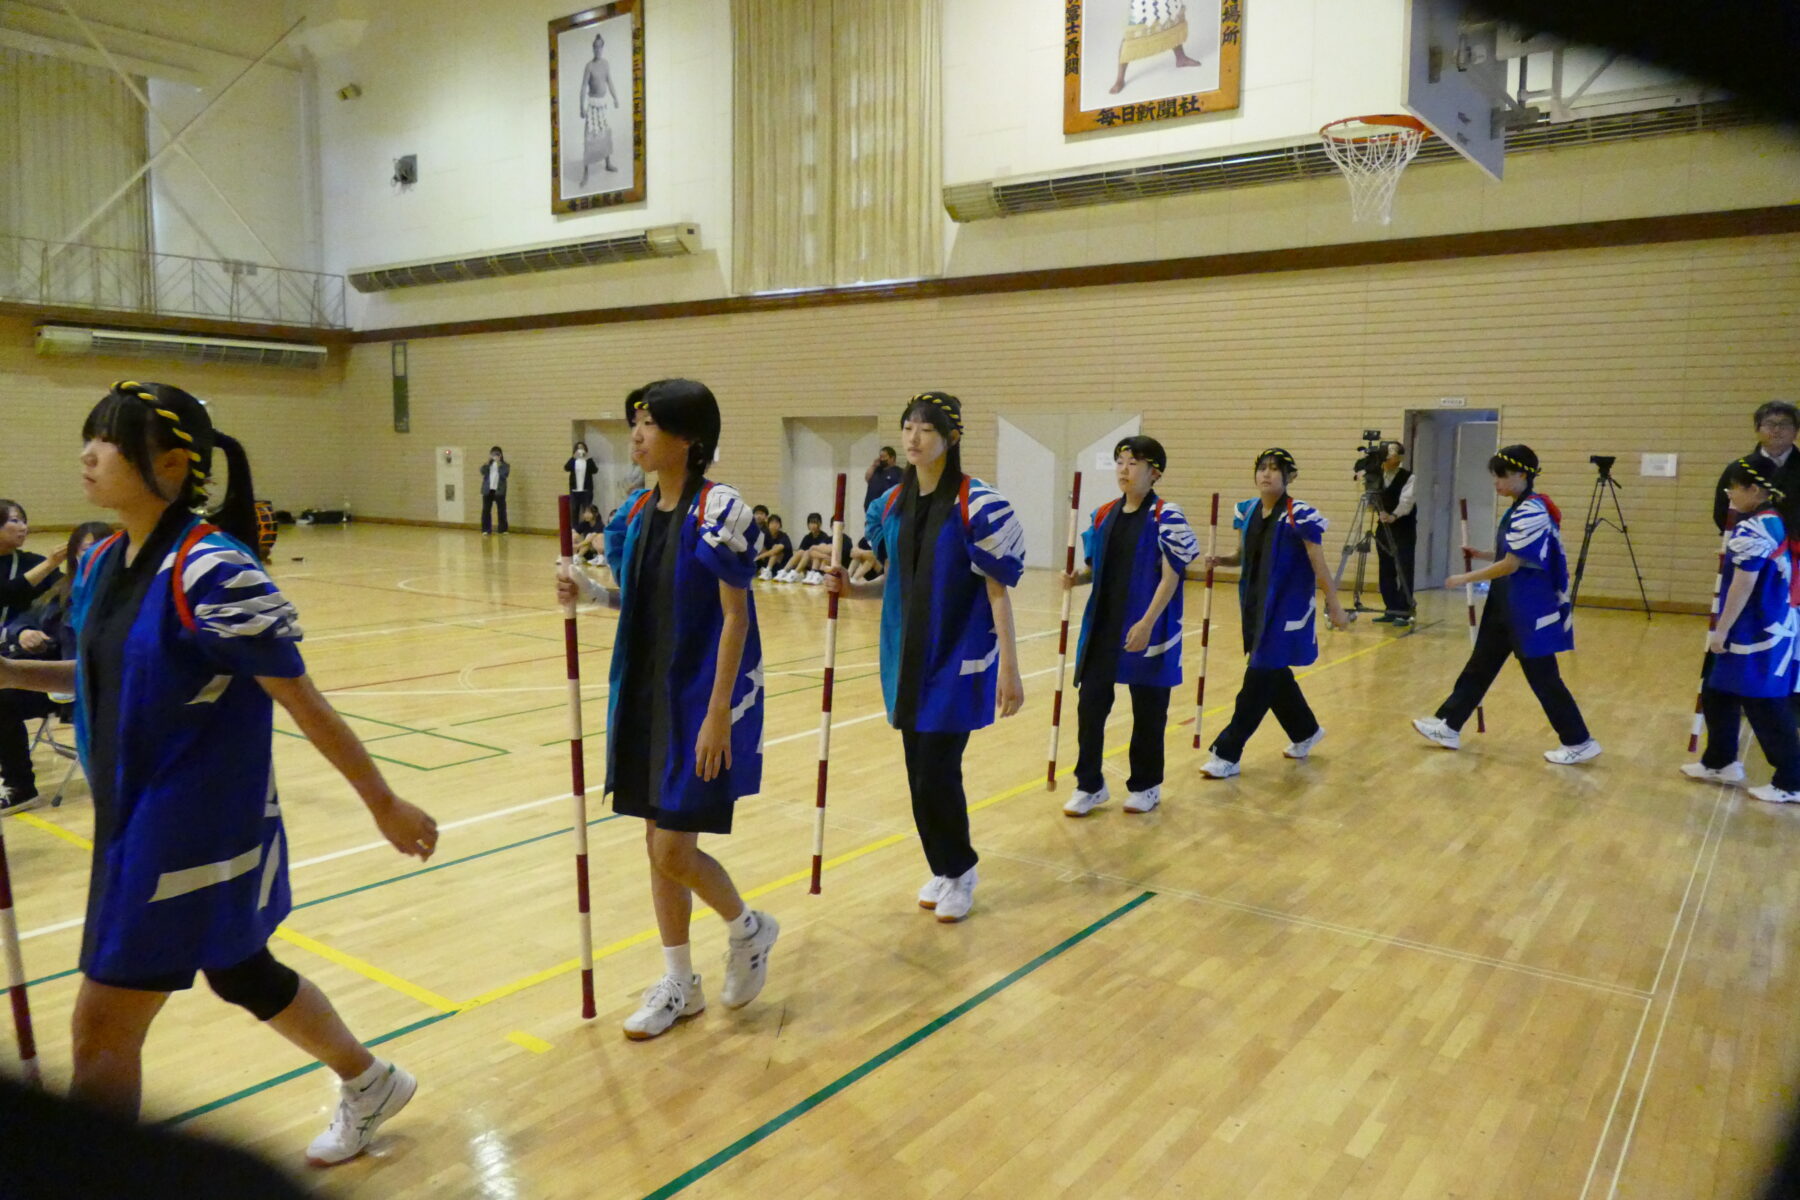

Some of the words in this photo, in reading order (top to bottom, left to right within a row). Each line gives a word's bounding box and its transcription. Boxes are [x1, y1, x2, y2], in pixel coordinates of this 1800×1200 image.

[1222, 0, 1240, 46] 場所
[1096, 95, 1201, 126] 毎日新聞社
